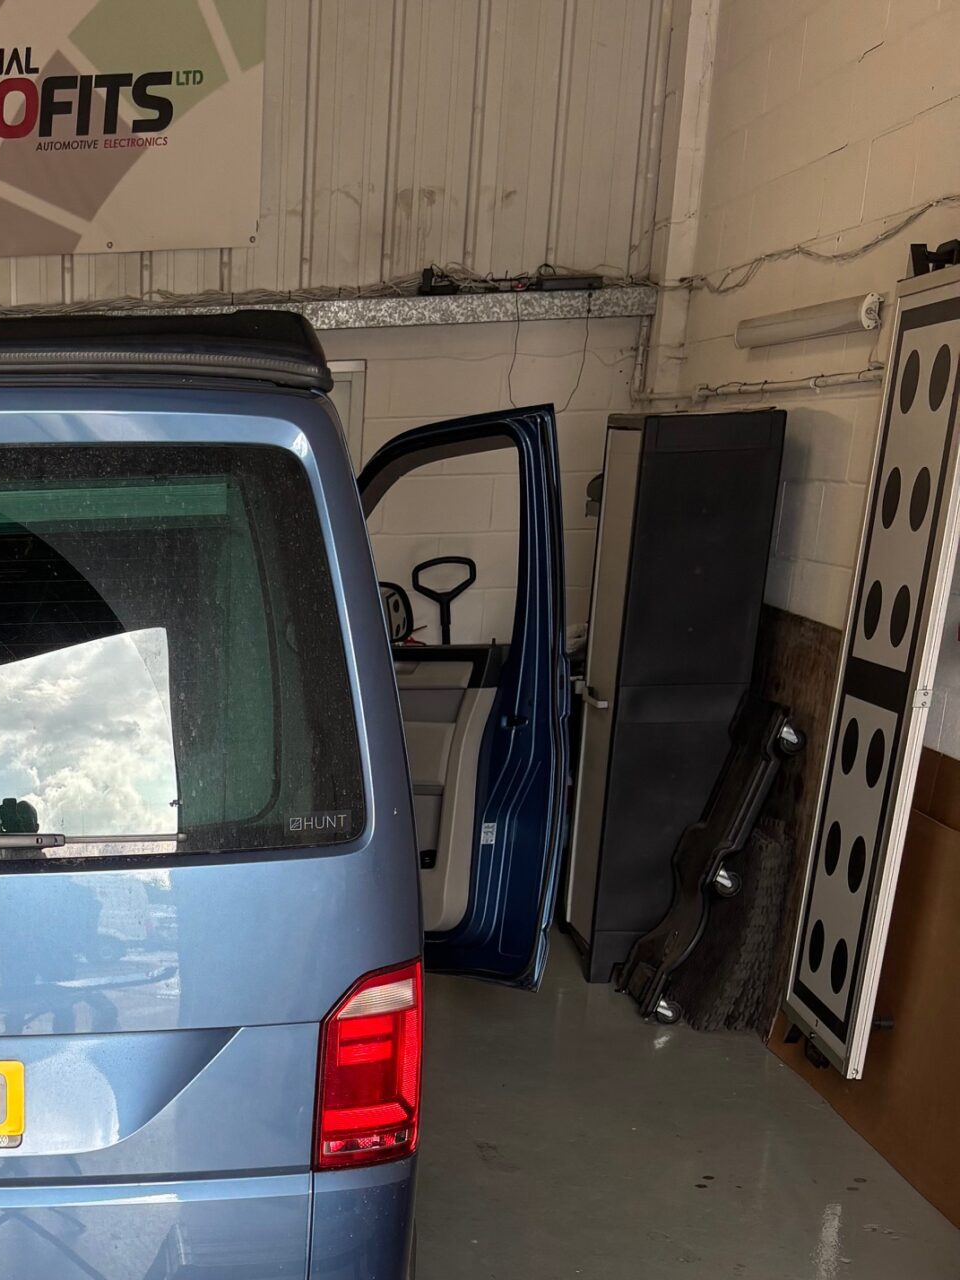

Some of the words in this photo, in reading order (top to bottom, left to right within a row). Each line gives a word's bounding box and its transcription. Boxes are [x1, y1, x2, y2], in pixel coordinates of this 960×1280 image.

[175, 70, 204, 86] LTD
[35, 139, 98, 152] AUTOMOTIVE
[103, 136, 169, 149] ELECTRONICS
[303, 814, 347, 830] HUNT
